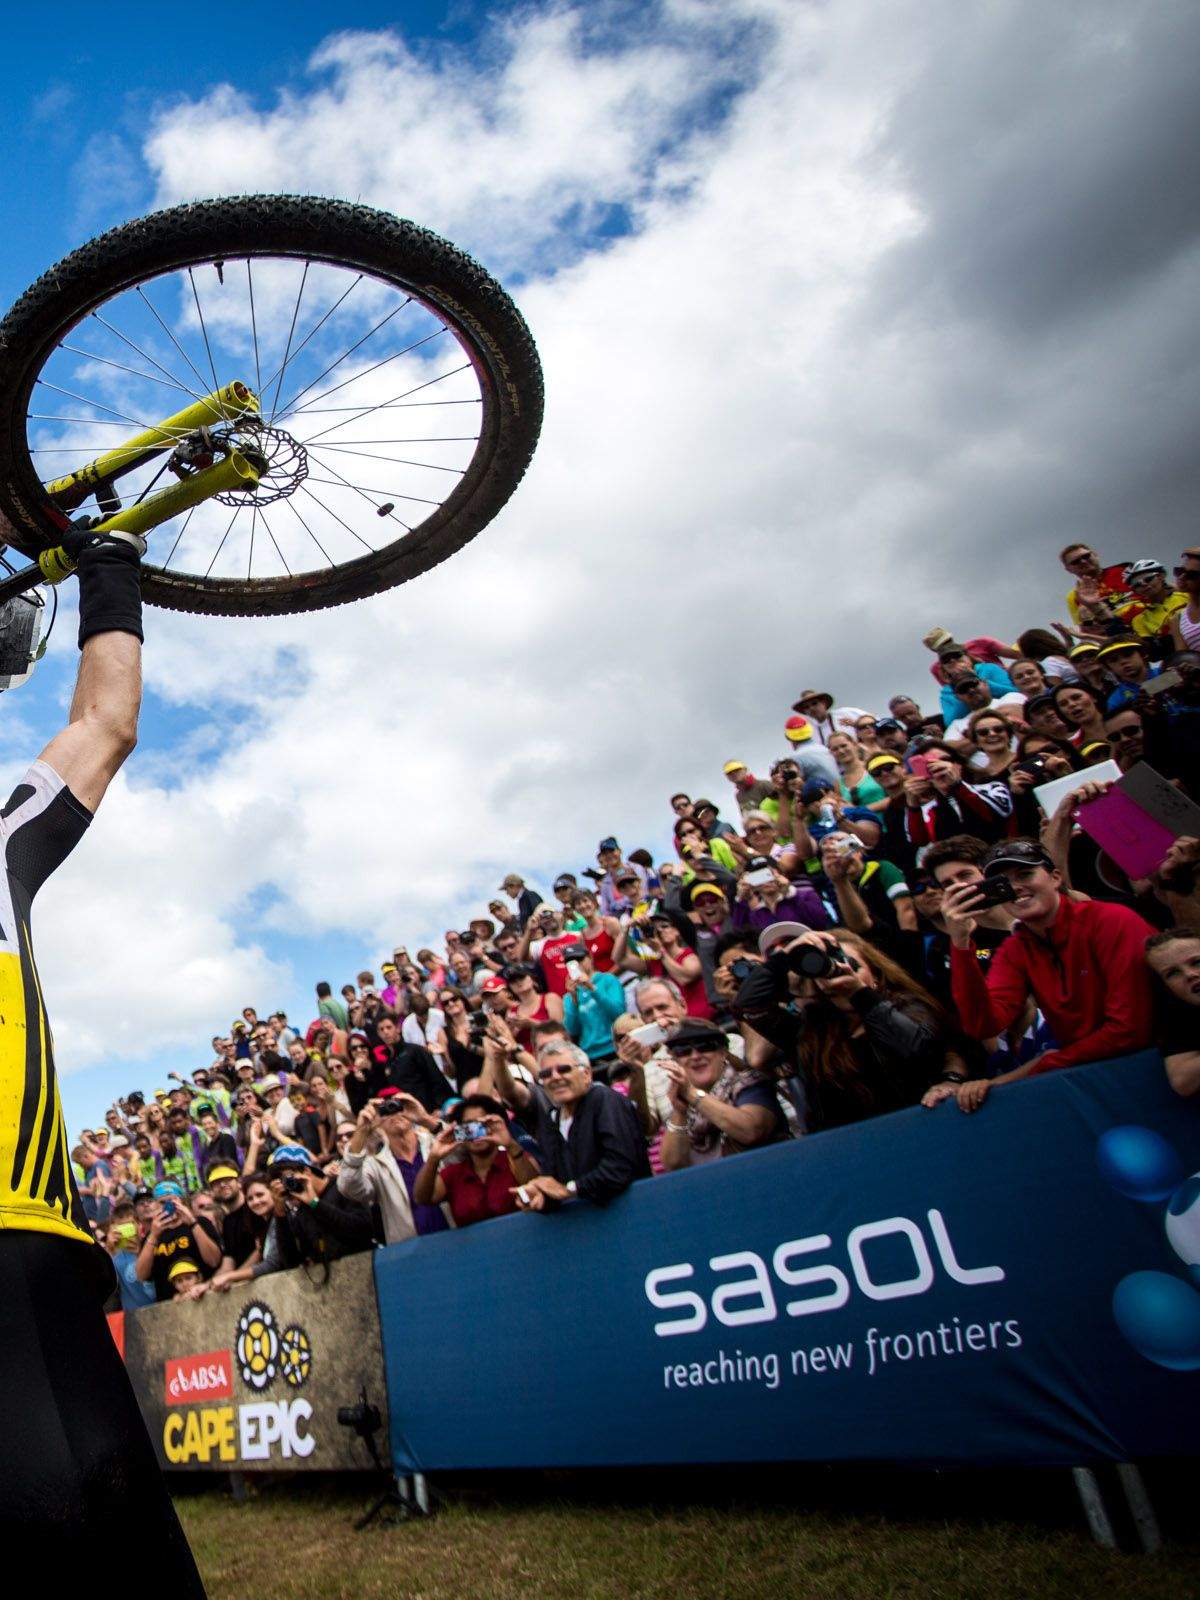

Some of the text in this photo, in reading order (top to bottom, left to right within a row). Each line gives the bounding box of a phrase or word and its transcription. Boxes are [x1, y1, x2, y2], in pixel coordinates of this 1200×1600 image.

[190, 1364, 228, 1391] ABSA
[663, 1317, 1023, 1390] reaching new frontiers
[163, 1397, 316, 1464] CAPE EPIC
